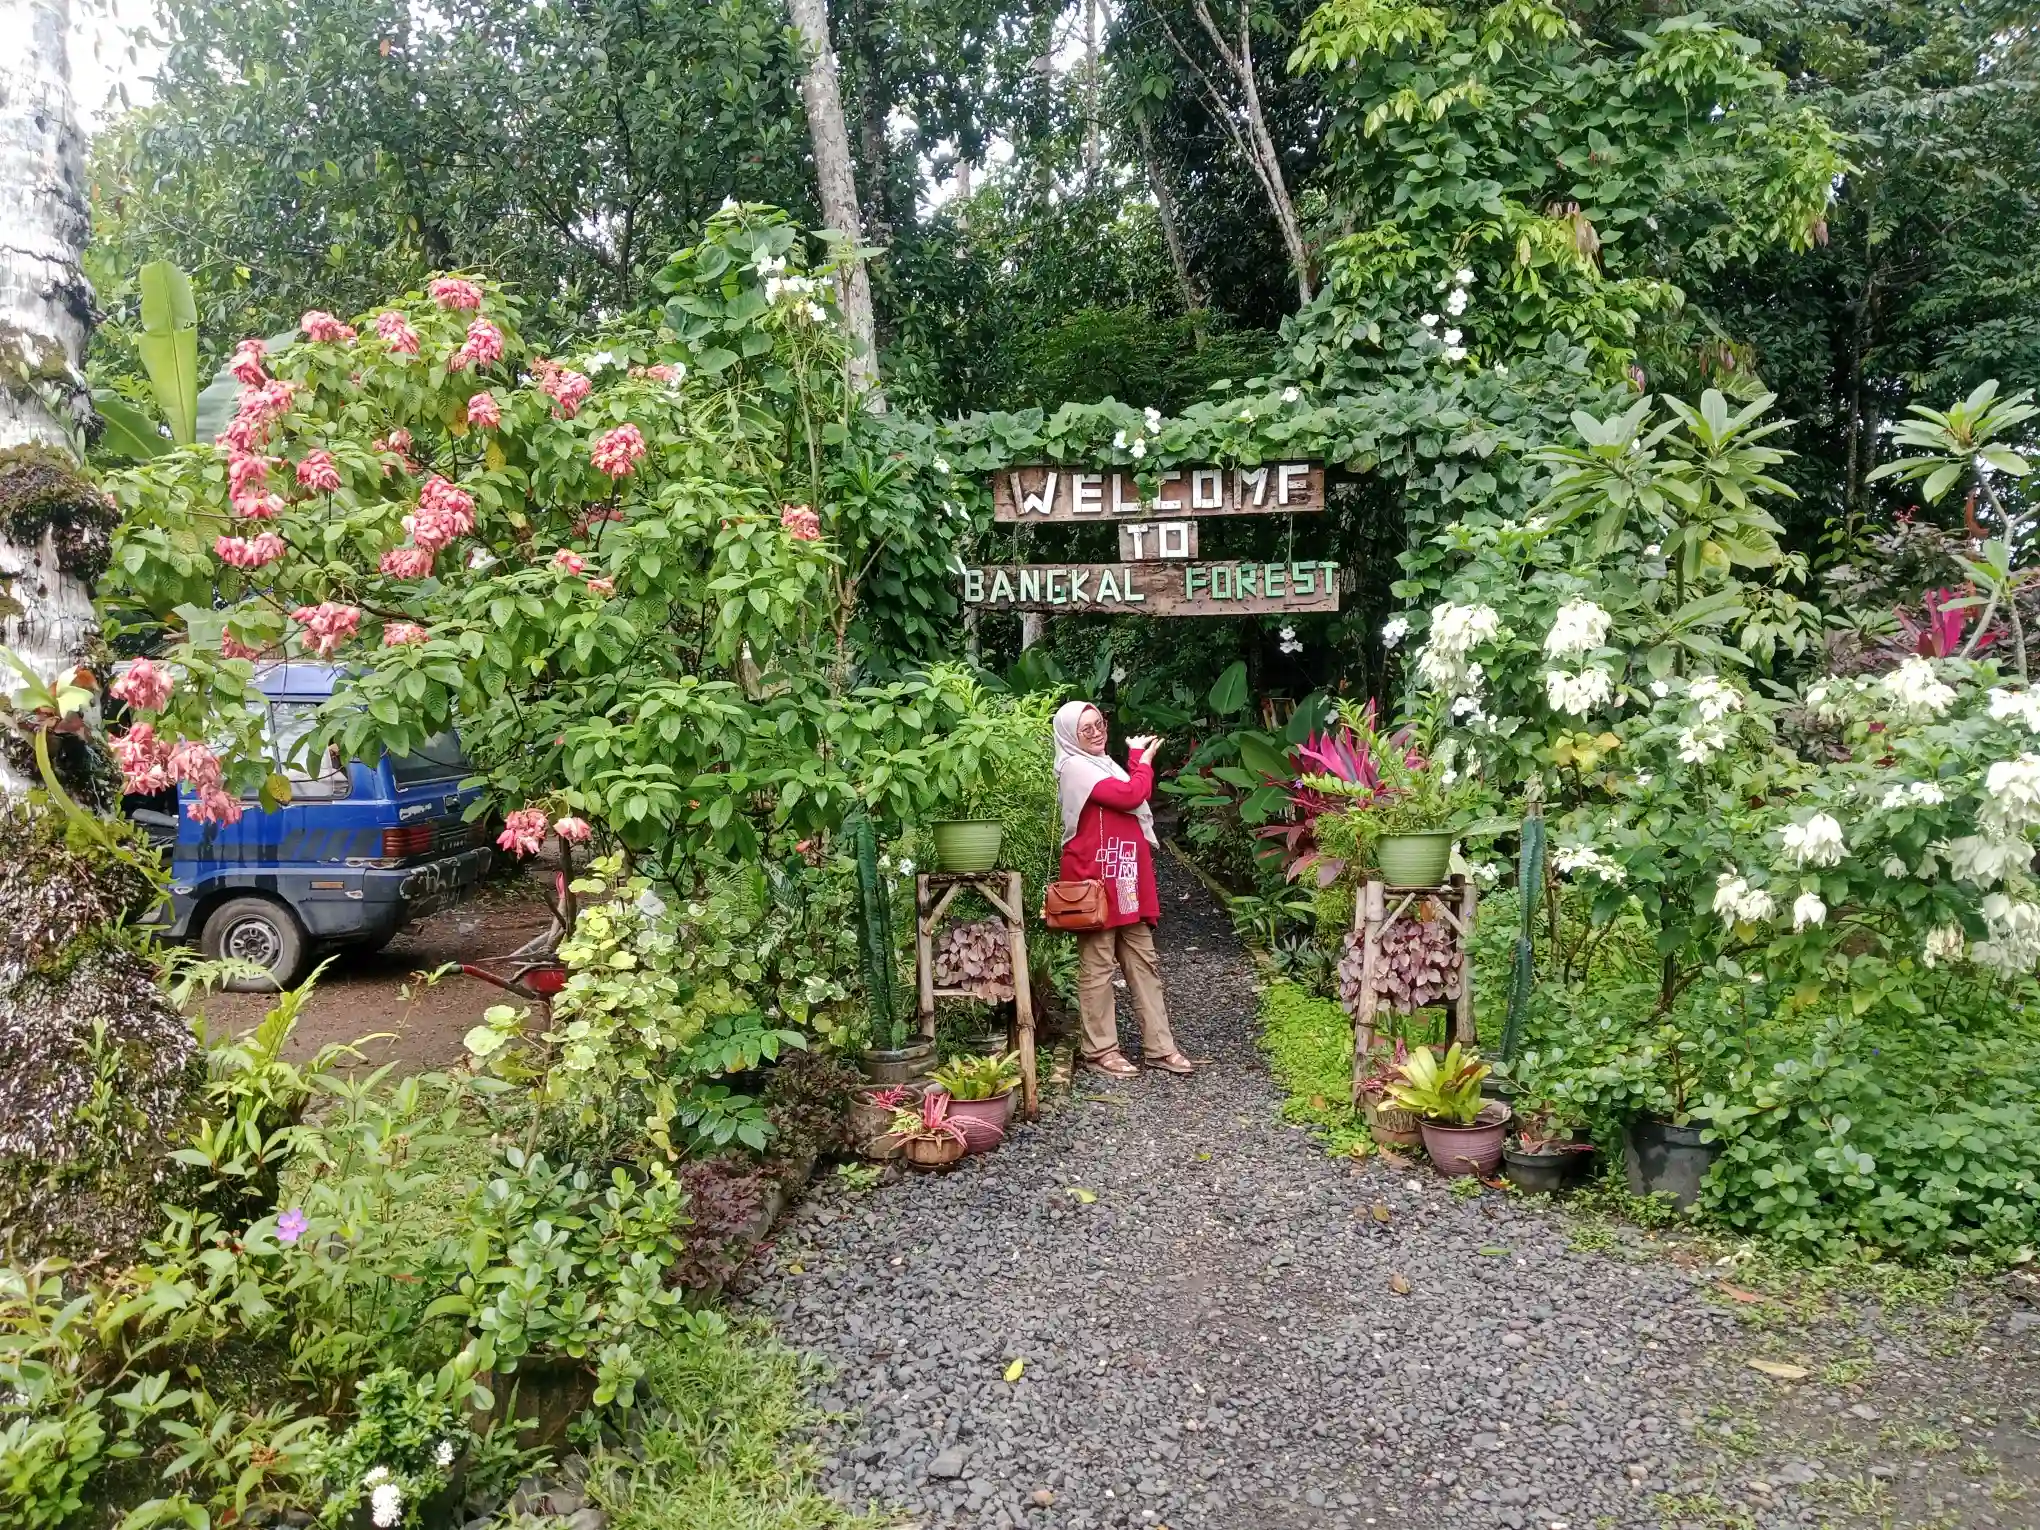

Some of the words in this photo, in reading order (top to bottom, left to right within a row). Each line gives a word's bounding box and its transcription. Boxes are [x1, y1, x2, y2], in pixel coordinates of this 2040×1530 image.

[1010, 464, 1309, 515] WELCOME
[1127, 522, 1189, 559] TO
[964, 569, 1145, 604] BANGKAL
[1186, 561, 1339, 600] FOREST
